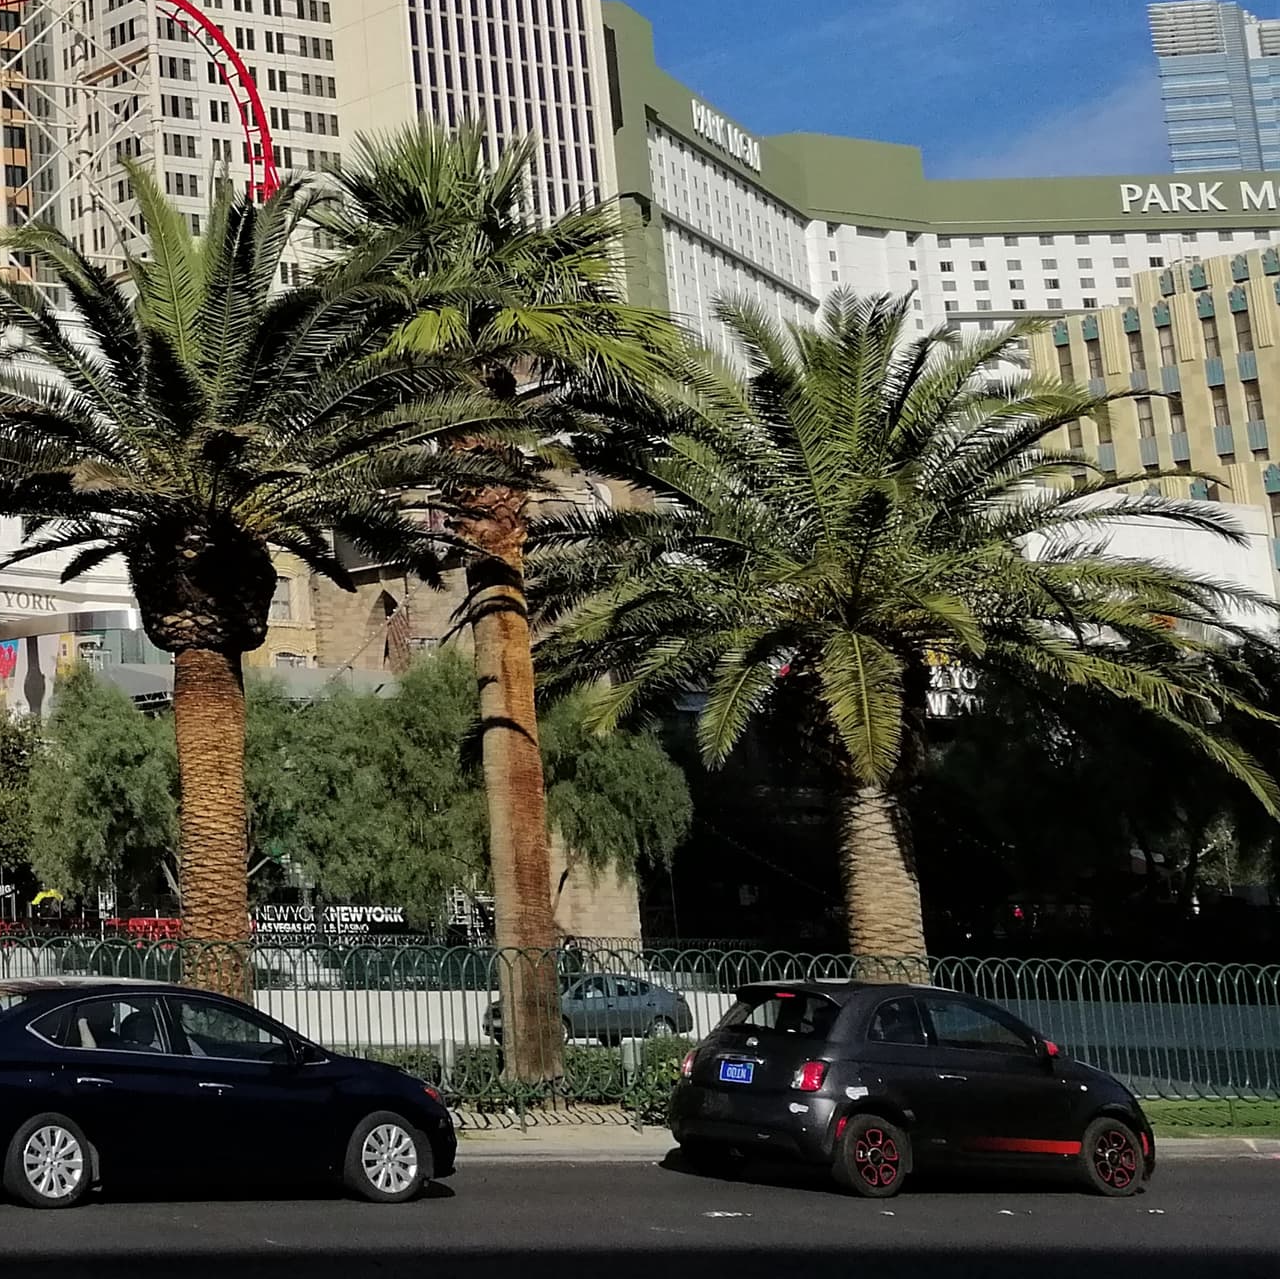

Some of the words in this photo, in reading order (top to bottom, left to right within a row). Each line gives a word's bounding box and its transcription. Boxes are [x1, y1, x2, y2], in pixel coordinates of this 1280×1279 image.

[691, 98, 728, 150] PARK
[1120, 182, 1228, 213] PARK
[1239, 180, 1280, 210] M
[3, 591, 58, 612] YORK
[256, 922, 272, 933] LAS
[273, 922, 301, 933] VEGAS
